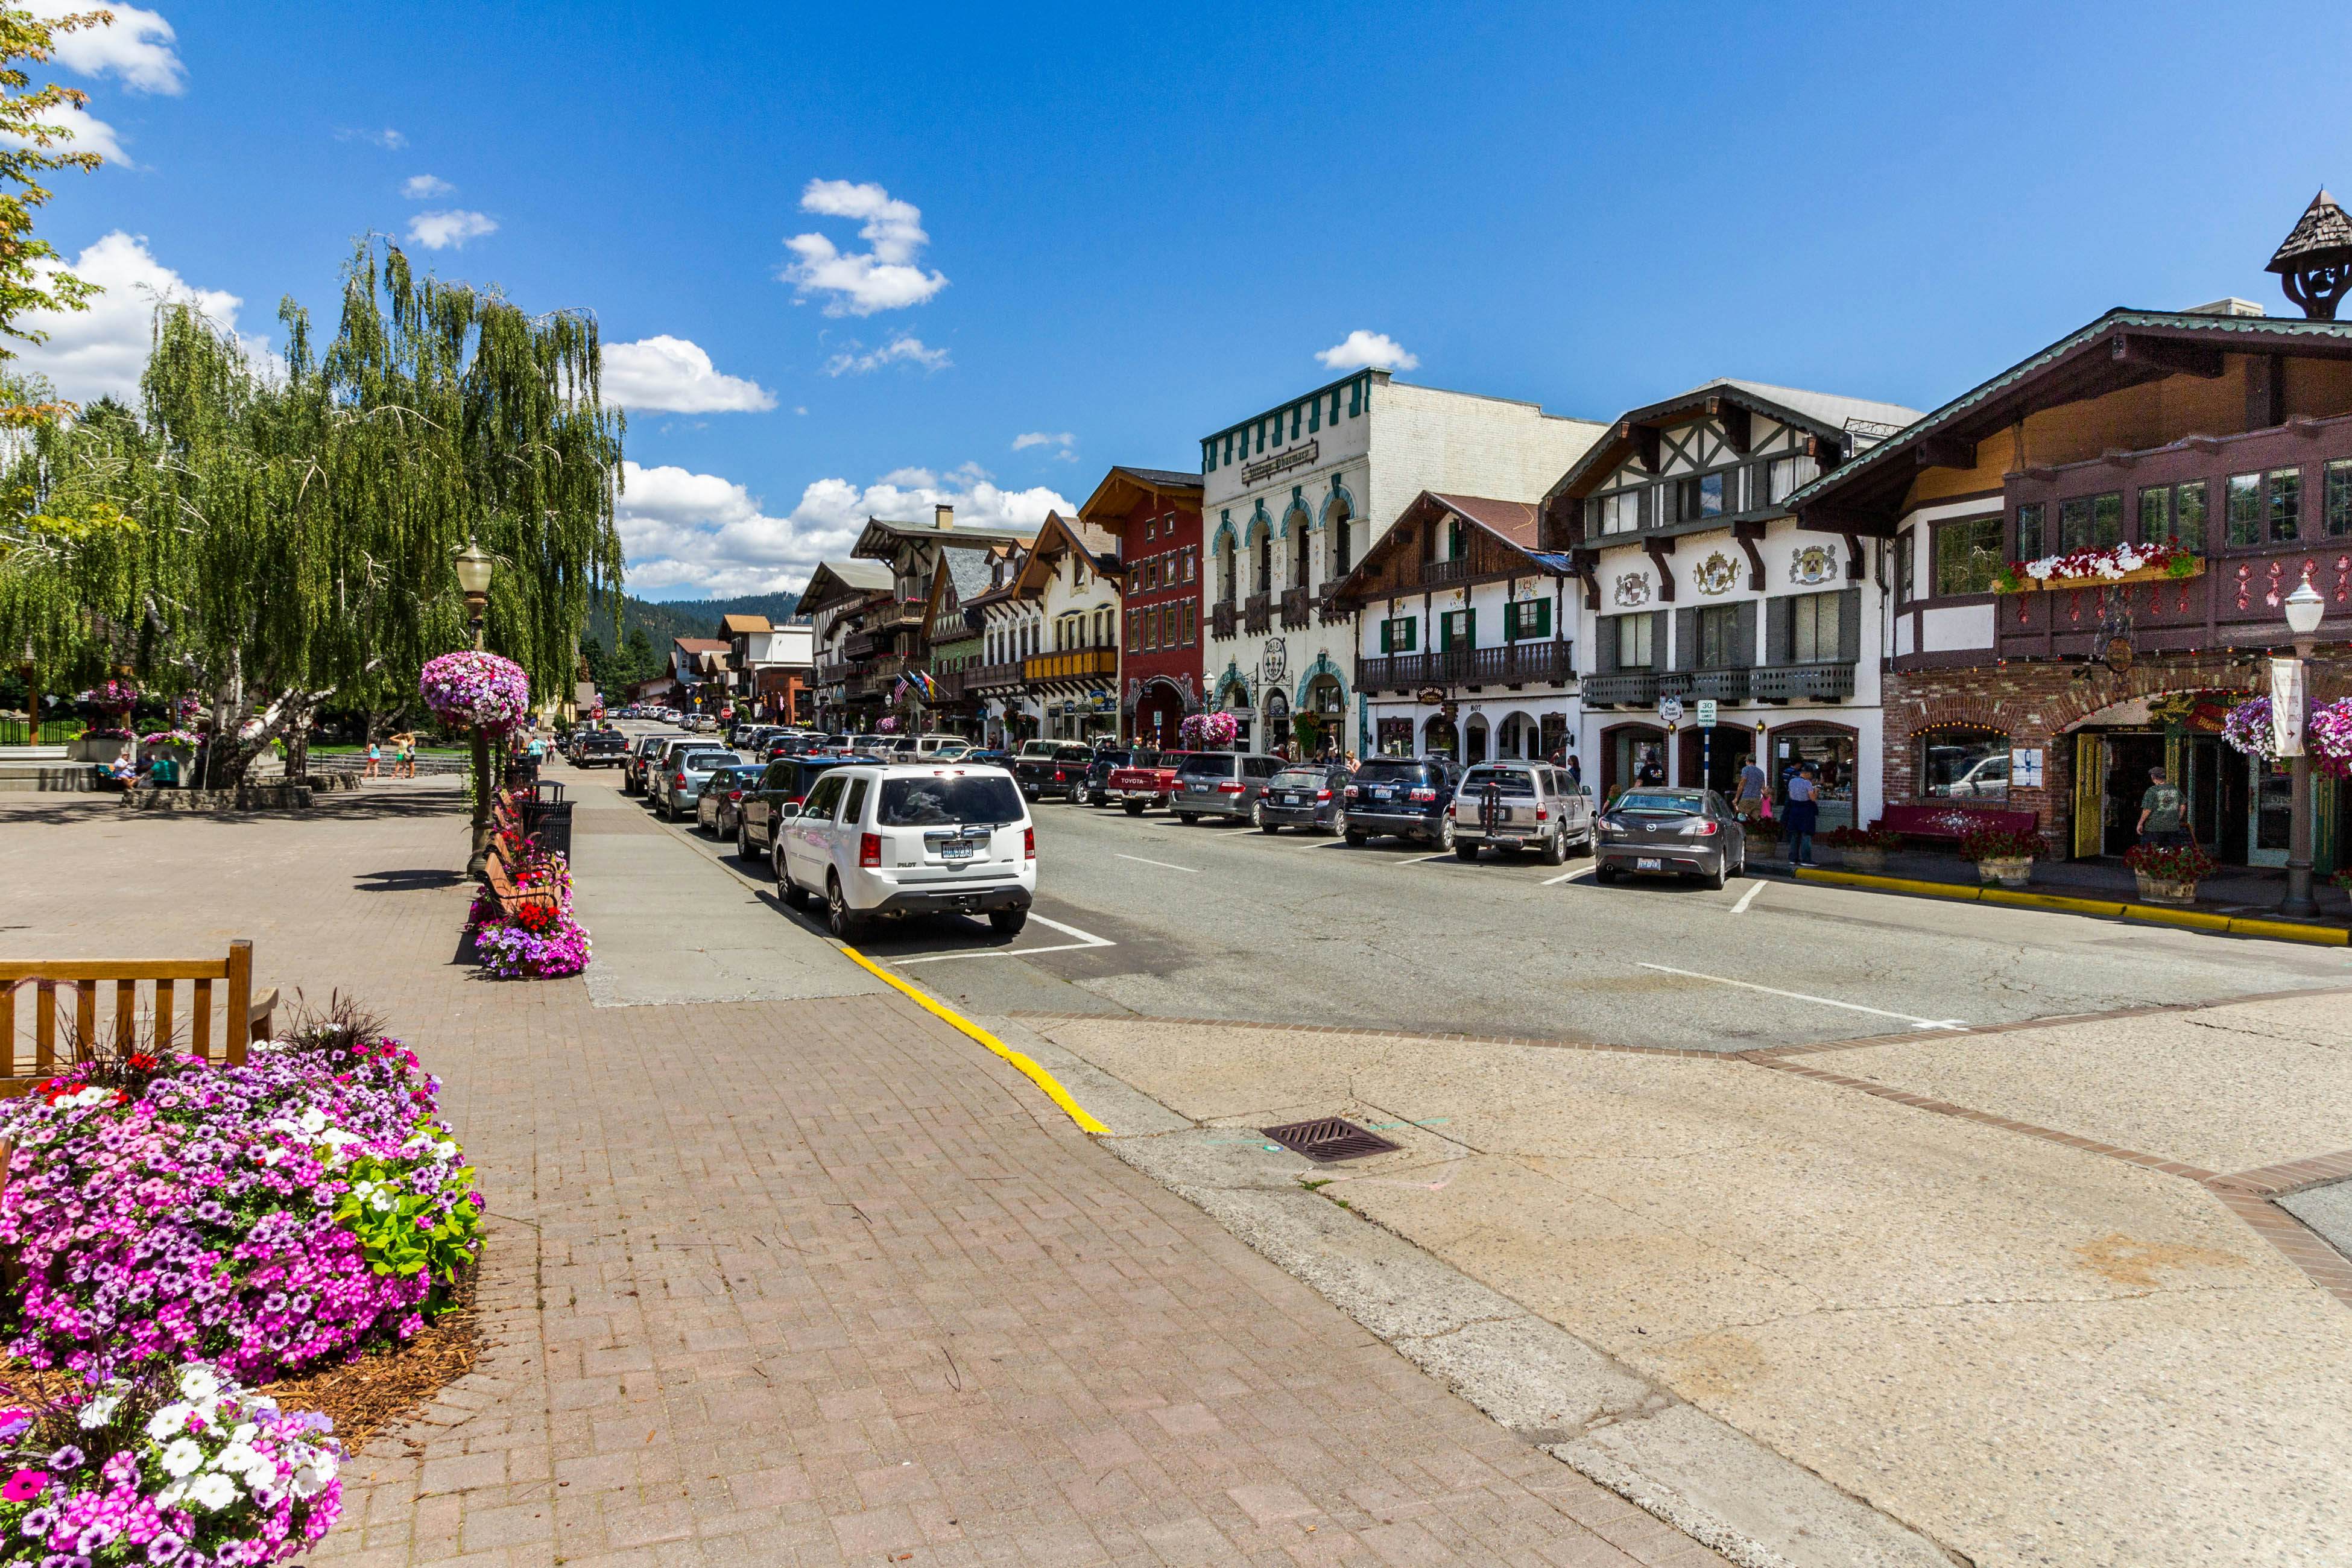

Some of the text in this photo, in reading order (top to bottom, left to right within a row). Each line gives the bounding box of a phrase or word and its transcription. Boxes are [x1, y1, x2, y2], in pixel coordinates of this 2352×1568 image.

[1276, 449, 1309, 470] Pharmacy
[1268, 641, 1279, 650] 815
[1419, 687, 1434, 697] Studio
